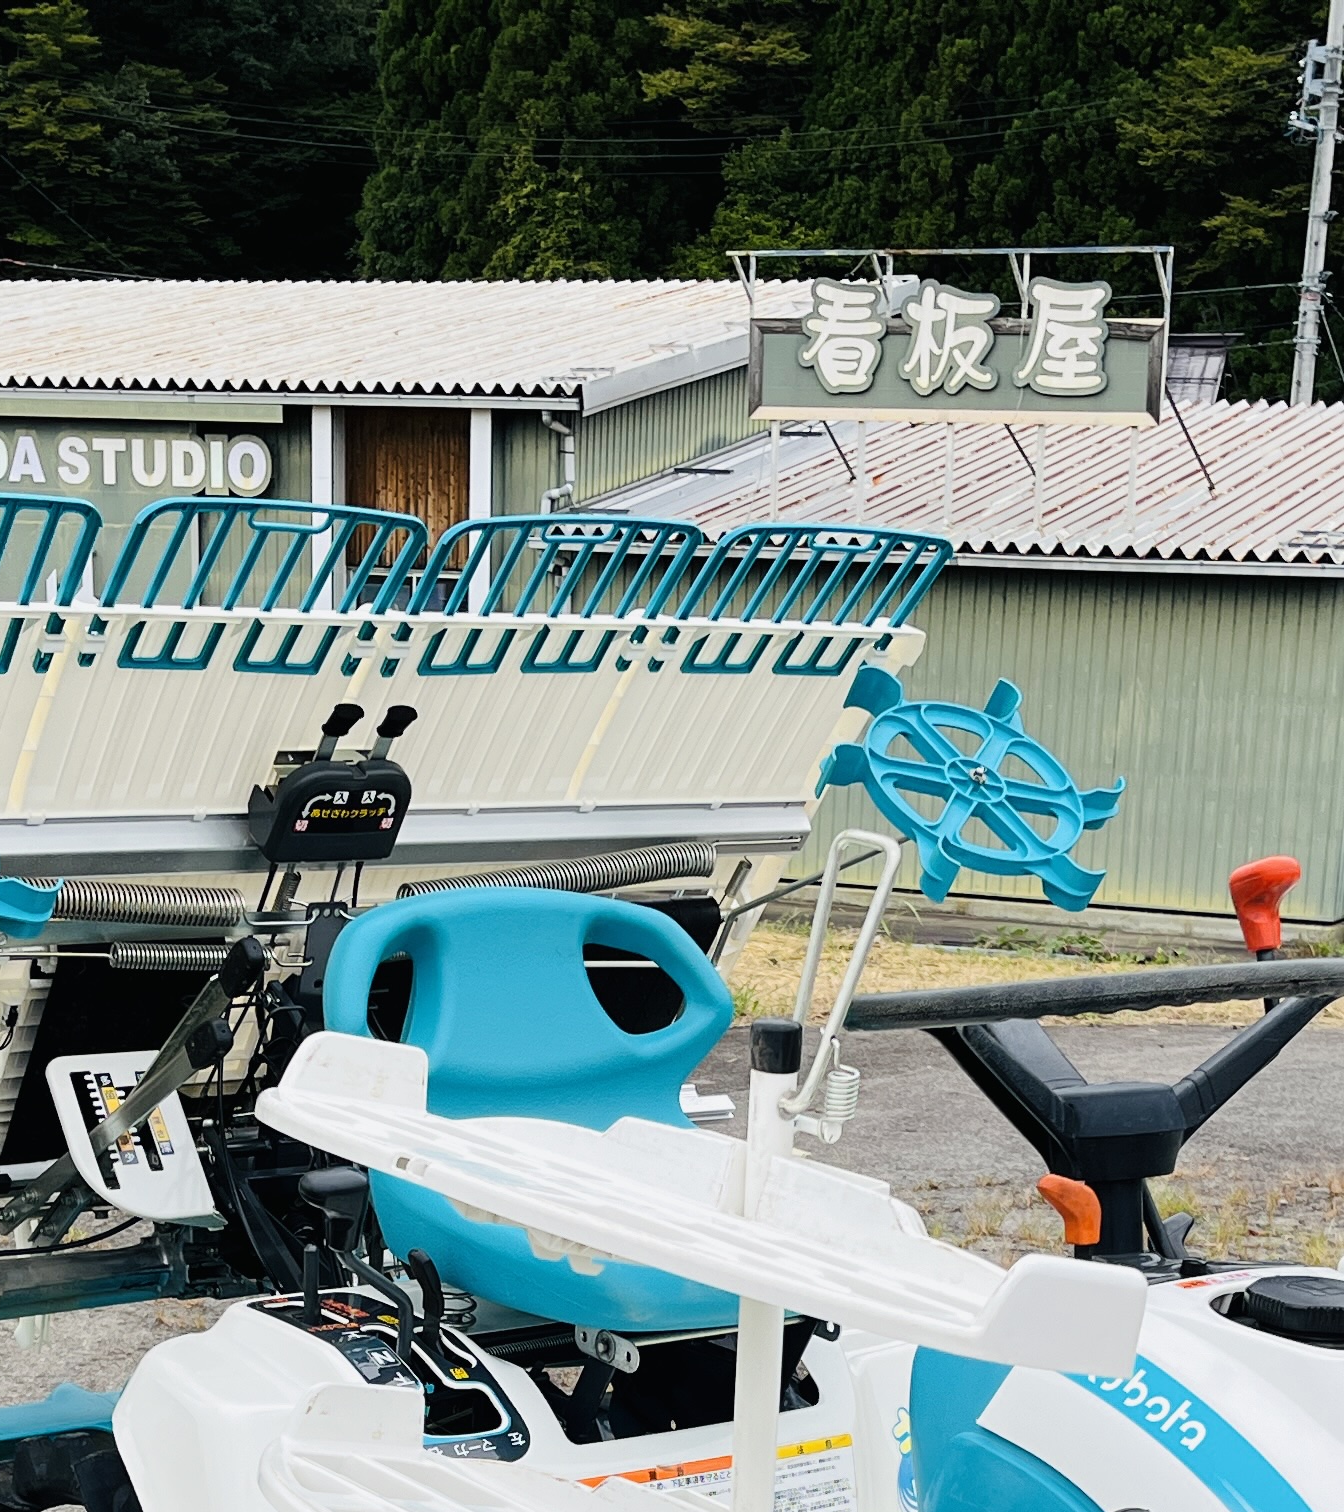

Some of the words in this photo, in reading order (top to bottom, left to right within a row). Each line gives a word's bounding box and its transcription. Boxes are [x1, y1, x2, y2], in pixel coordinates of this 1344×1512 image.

[801, 281, 1105, 390] 看板屋
[57, 435, 269, 490] STUDIO
[335, 791, 347, 803] 入
[362, 791, 375, 803] 入
[1087, 1368, 1207, 1452] bota
[453, 1439, 497, 1457] マーカ
